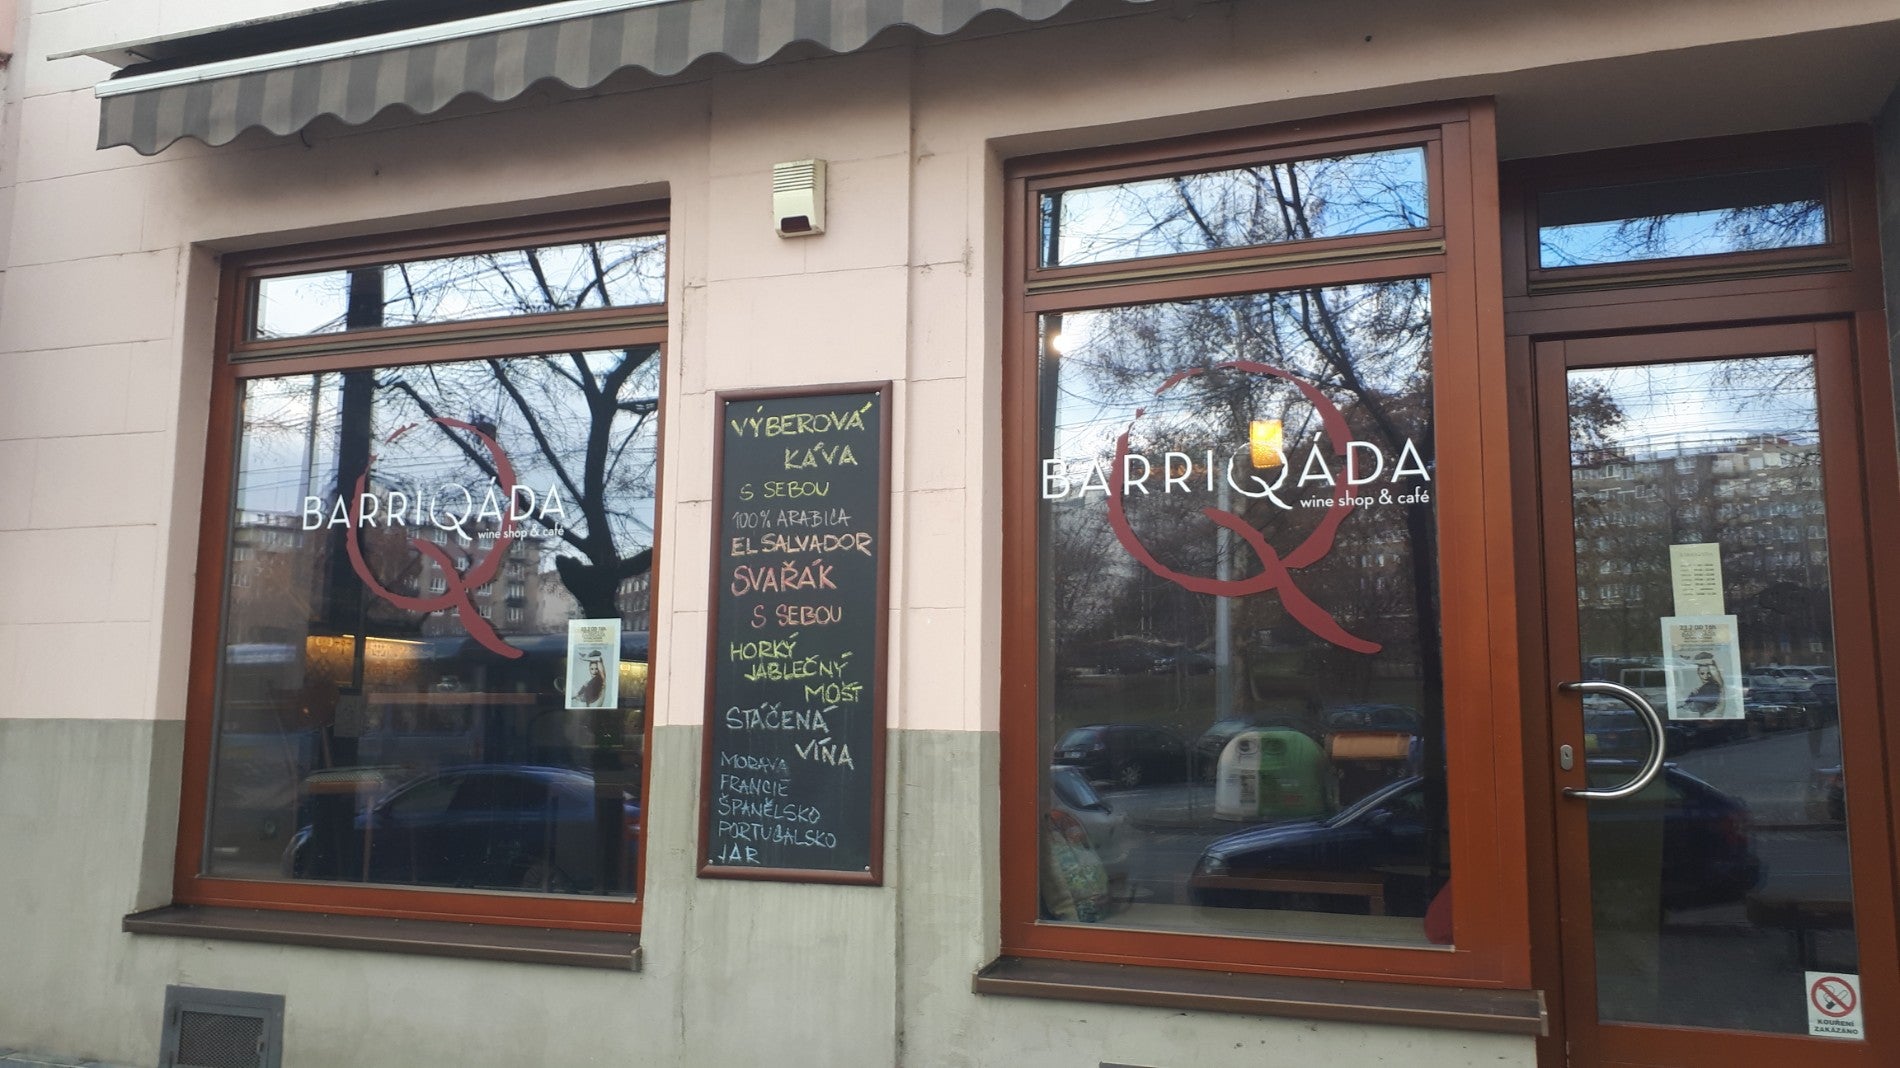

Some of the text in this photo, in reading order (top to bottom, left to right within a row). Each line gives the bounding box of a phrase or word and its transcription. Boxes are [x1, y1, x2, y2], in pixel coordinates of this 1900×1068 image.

[784, 441, 858, 470] KÁVA
[1042, 432, 1431, 510] BARRIQÁDA
[740, 481, 829, 500] S SEBOU
[1300, 486, 1430, 510] wine shop & café
[302, 477, 565, 541] BARRIQÁDA
[732, 508, 852, 529] 100% ARABICA
[478, 521, 565, 541] wine shop & café
[731, 532, 872, 556] EL SALVADOR
[731, 558, 838, 597] SVAŘÁK
[751, 603, 842, 628] S SEBOU
[730, 632, 799, 661] HORKÝ
[744, 651, 854, 681] JABLEČNÝ
[804, 681, 864, 703] MOŠT
[726, 702, 838, 733] STÁČENÁ
[721, 752, 789, 773] MORAVA
[795, 737, 854, 770] VÍNA
[720, 774, 791, 797] FRANCIE
[718, 795, 821, 824] ŠPANĚLSKO
[718, 844, 760, 864] JAR
